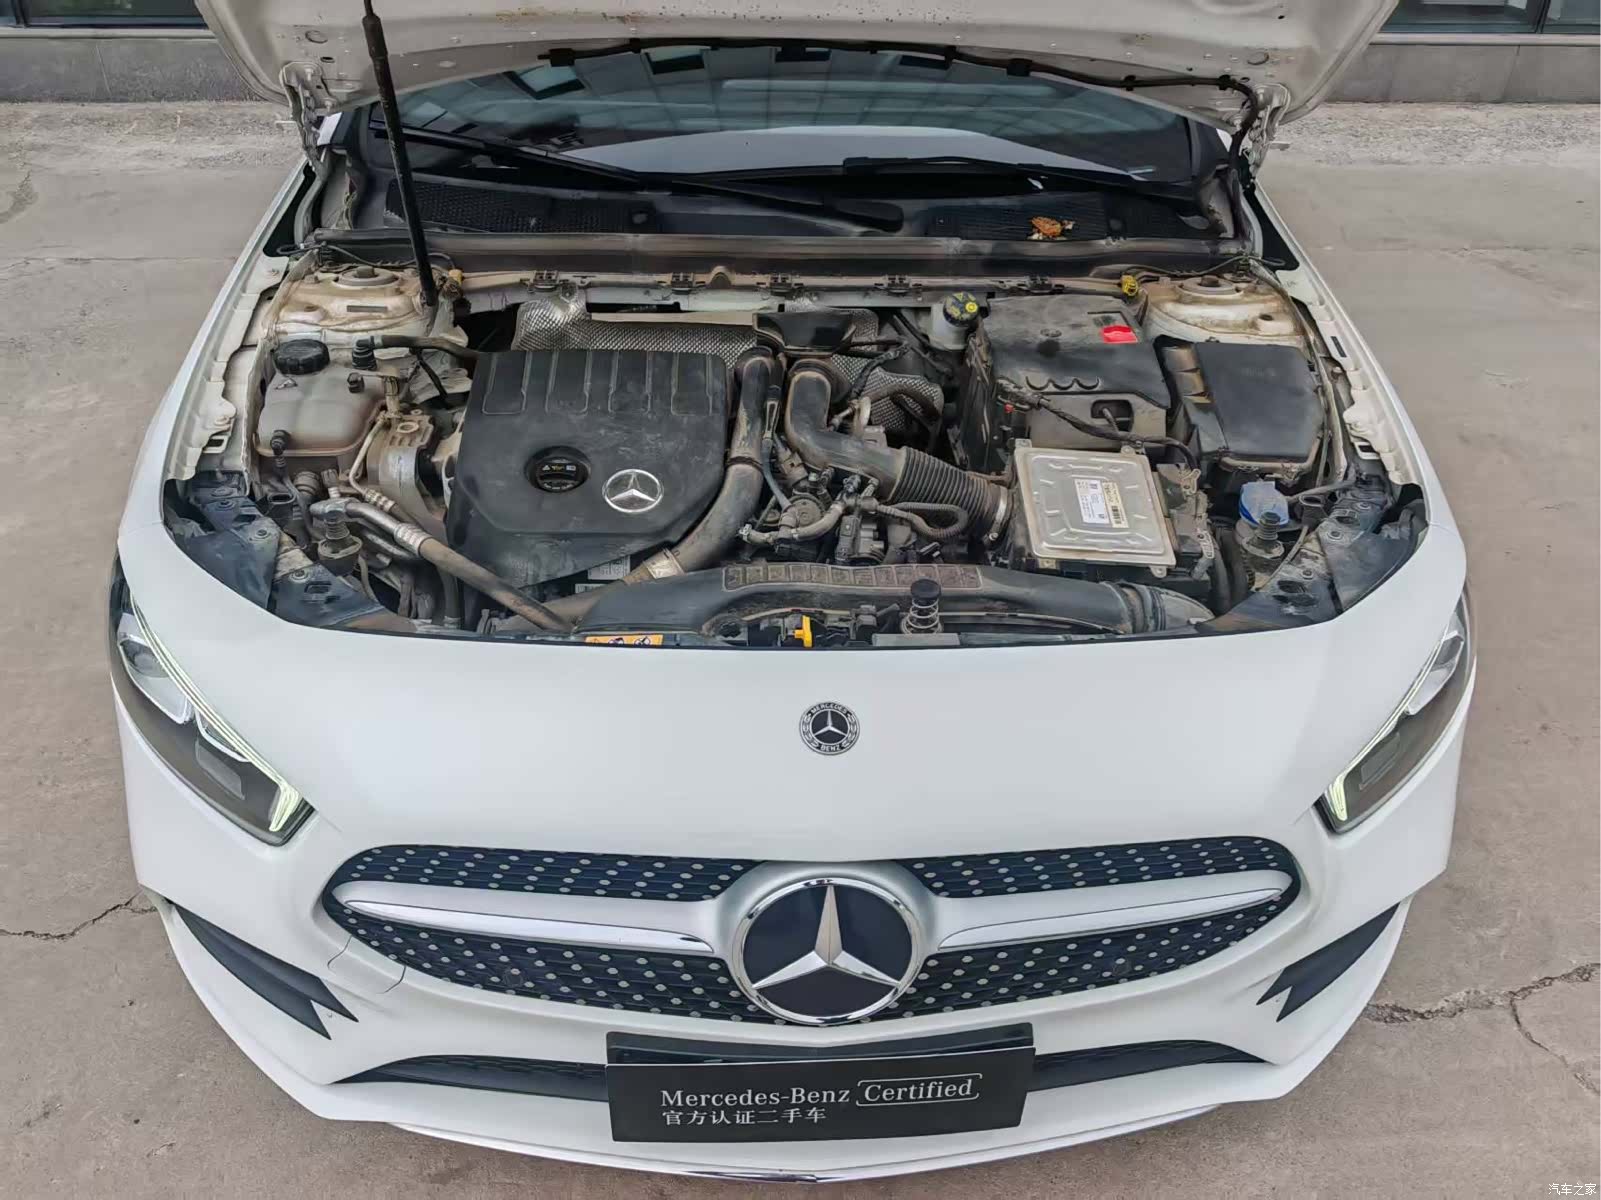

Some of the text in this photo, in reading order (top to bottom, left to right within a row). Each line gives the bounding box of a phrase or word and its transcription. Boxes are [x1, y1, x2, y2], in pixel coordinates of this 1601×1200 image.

[811, 703, 847, 714] MERCEDES
[820, 744, 841, 752] BENZ
[660, 1078, 973, 1107] Mercedes-Benz Certified
[662, 1107, 827, 1126] 官方认证二手车
